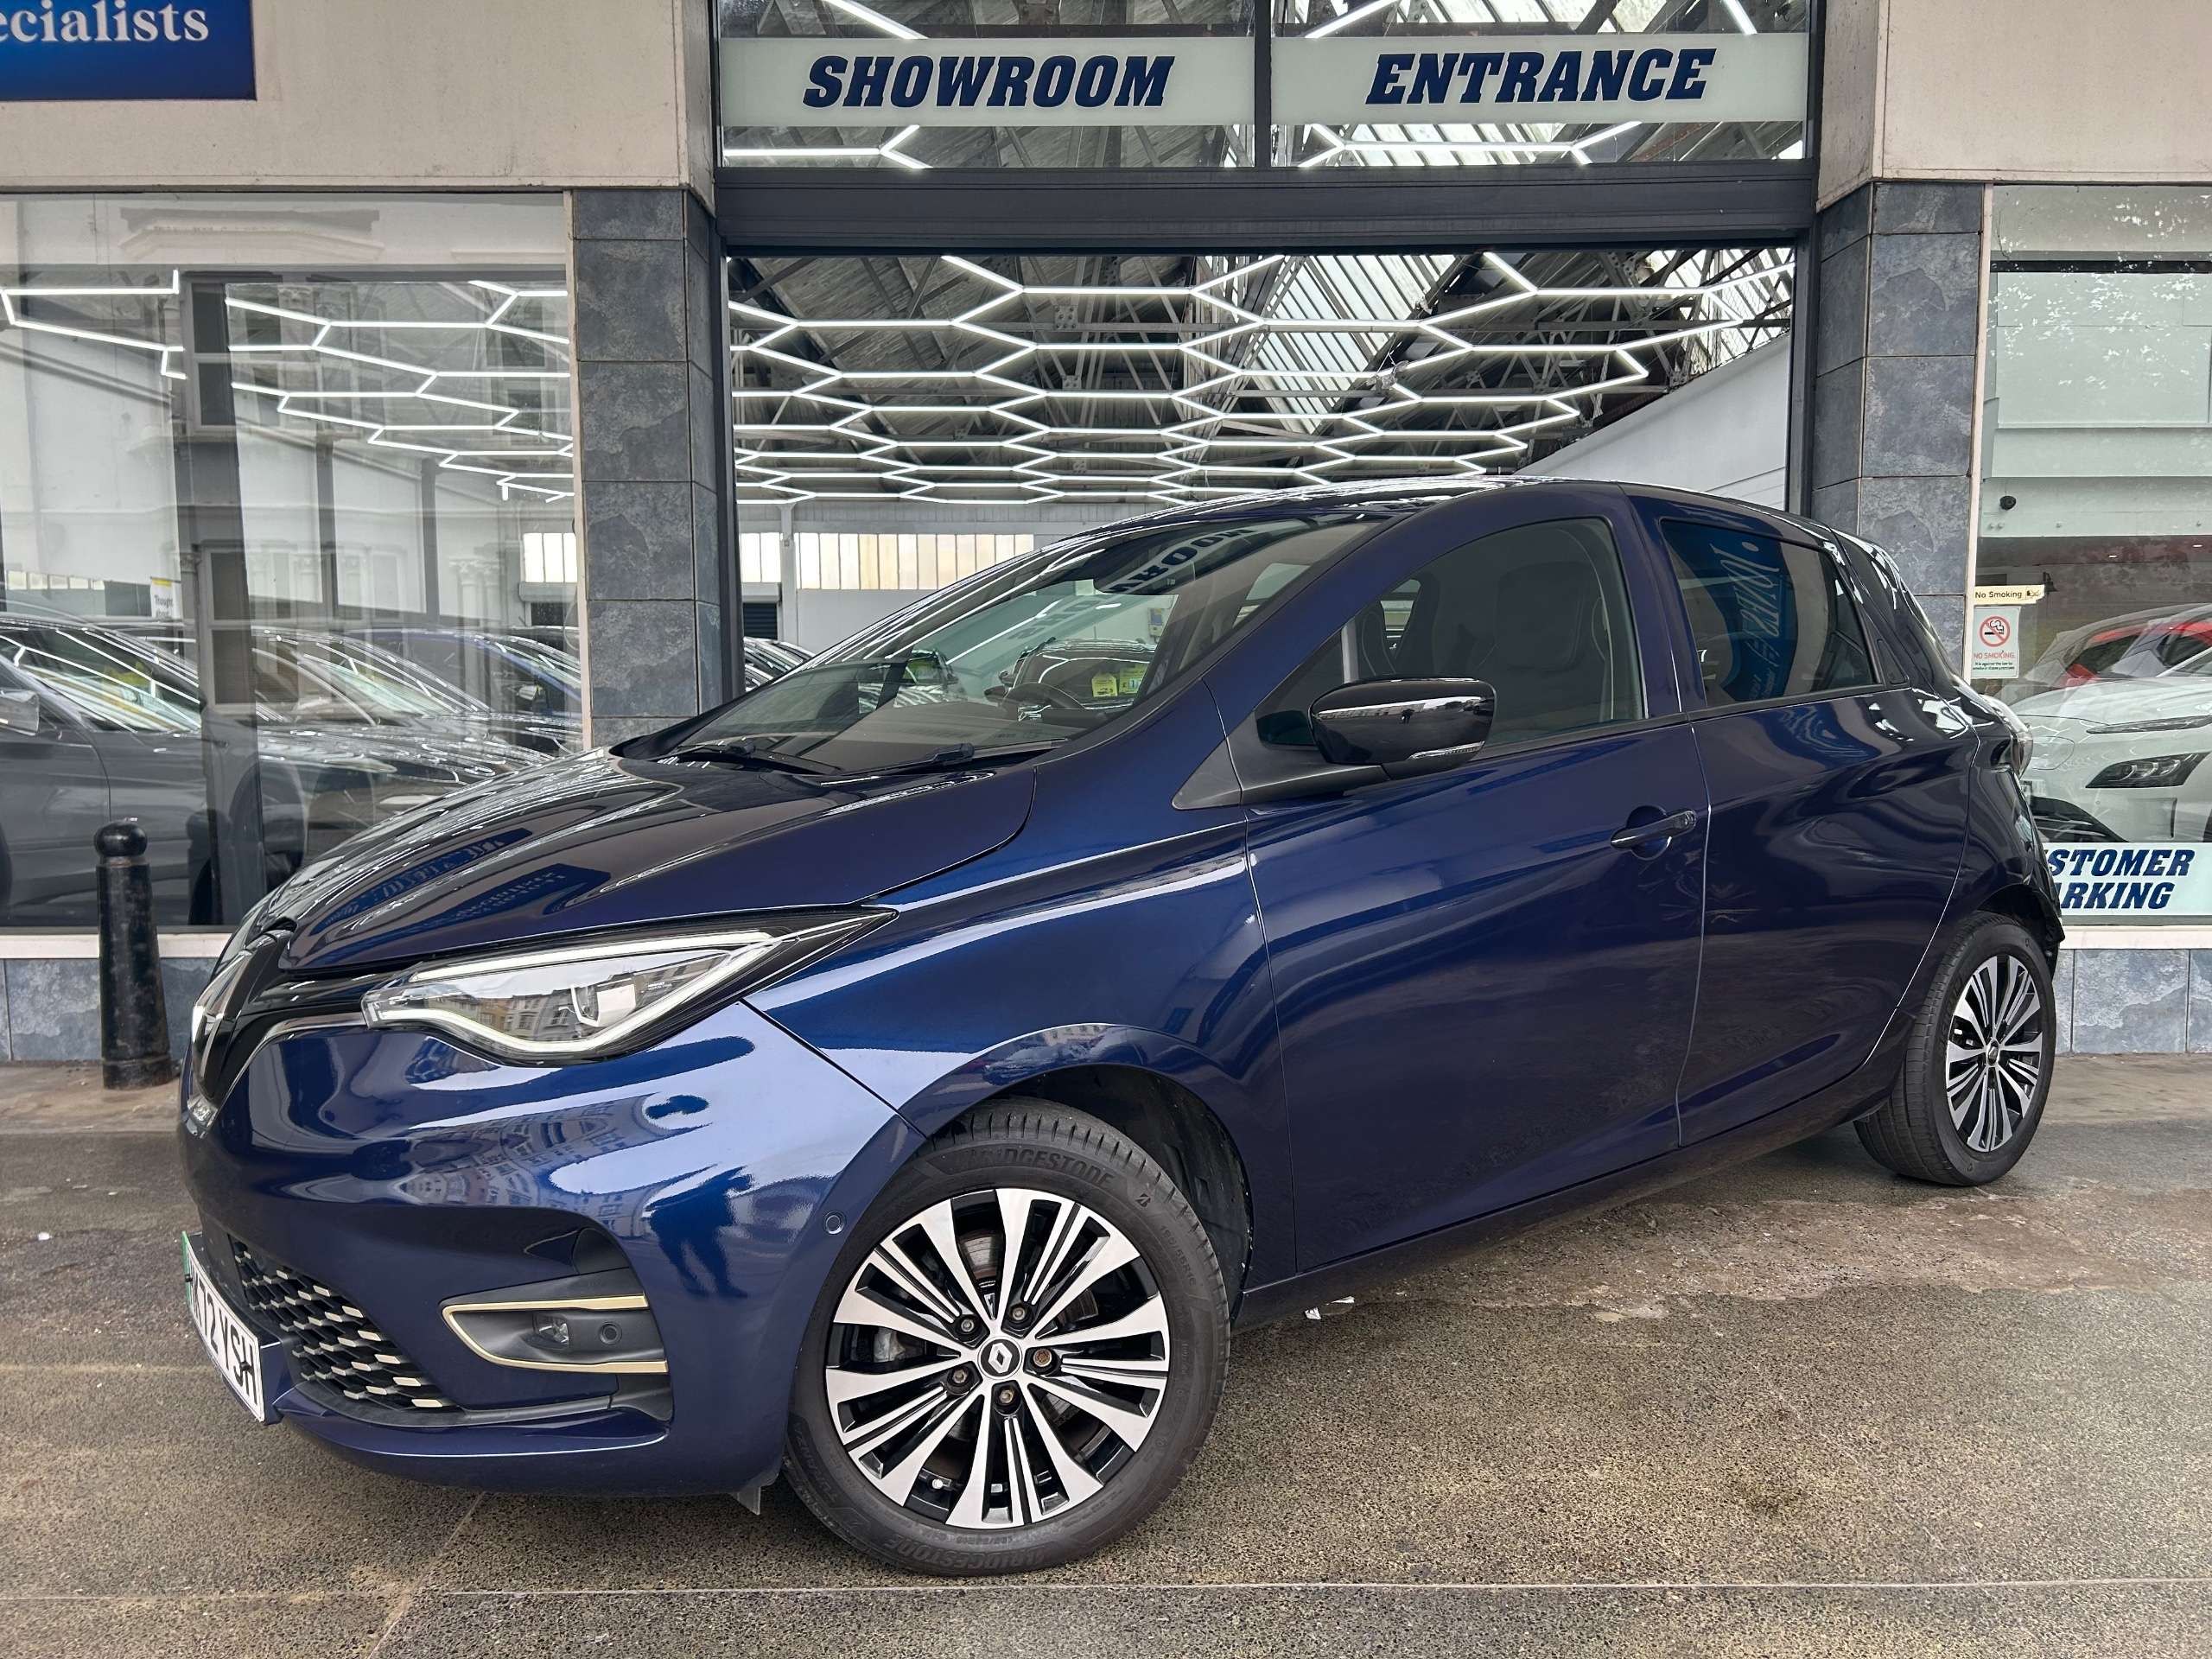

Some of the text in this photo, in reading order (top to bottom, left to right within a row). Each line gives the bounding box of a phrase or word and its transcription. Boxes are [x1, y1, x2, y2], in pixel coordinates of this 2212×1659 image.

[802, 48, 1717, 108] SHOWROOM ENTRANCE
[2044, 849, 2196, 877] STOMER
[2056, 881, 2175, 910] RKING
[219, 1307, 258, 1406] YSH
